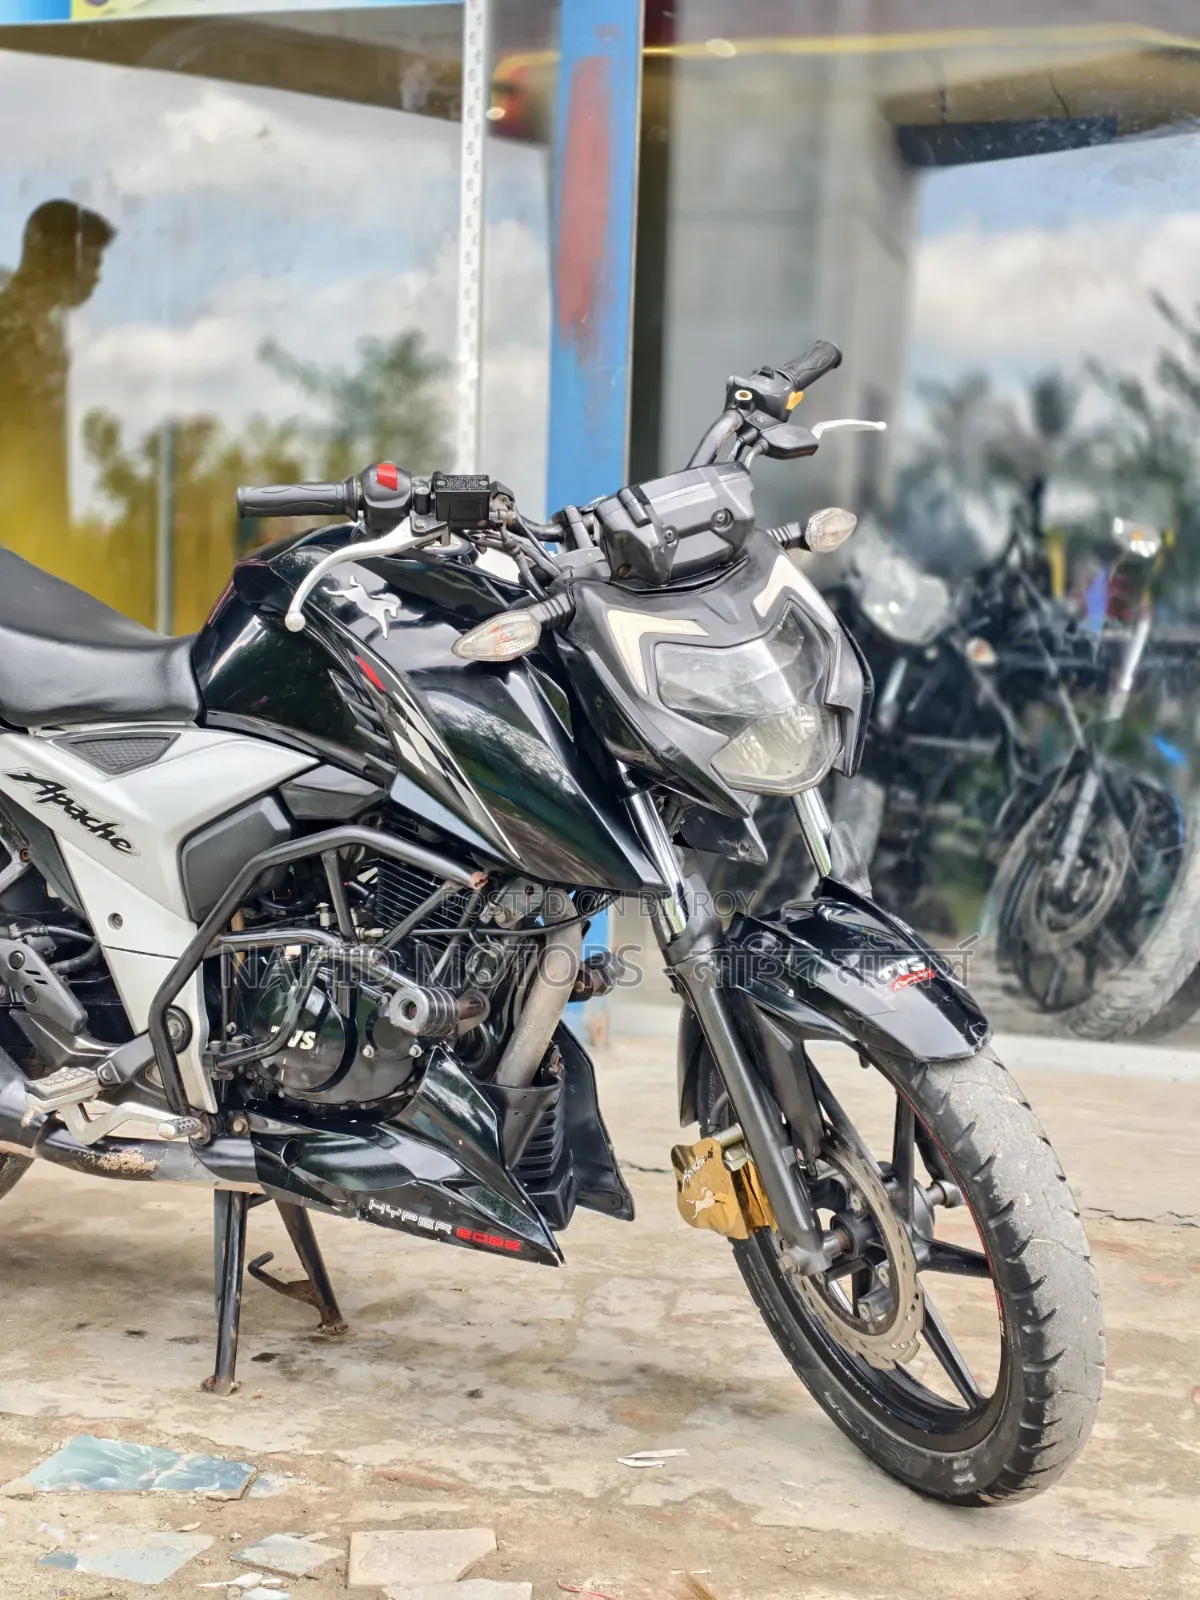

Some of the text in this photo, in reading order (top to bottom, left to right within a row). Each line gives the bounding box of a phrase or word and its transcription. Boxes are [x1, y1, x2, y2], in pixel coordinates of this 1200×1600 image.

[4, 771, 136, 856] Apache
[271, 1025, 316, 1050] VS
[369, 1198, 521, 1251] HYPER EDGE
